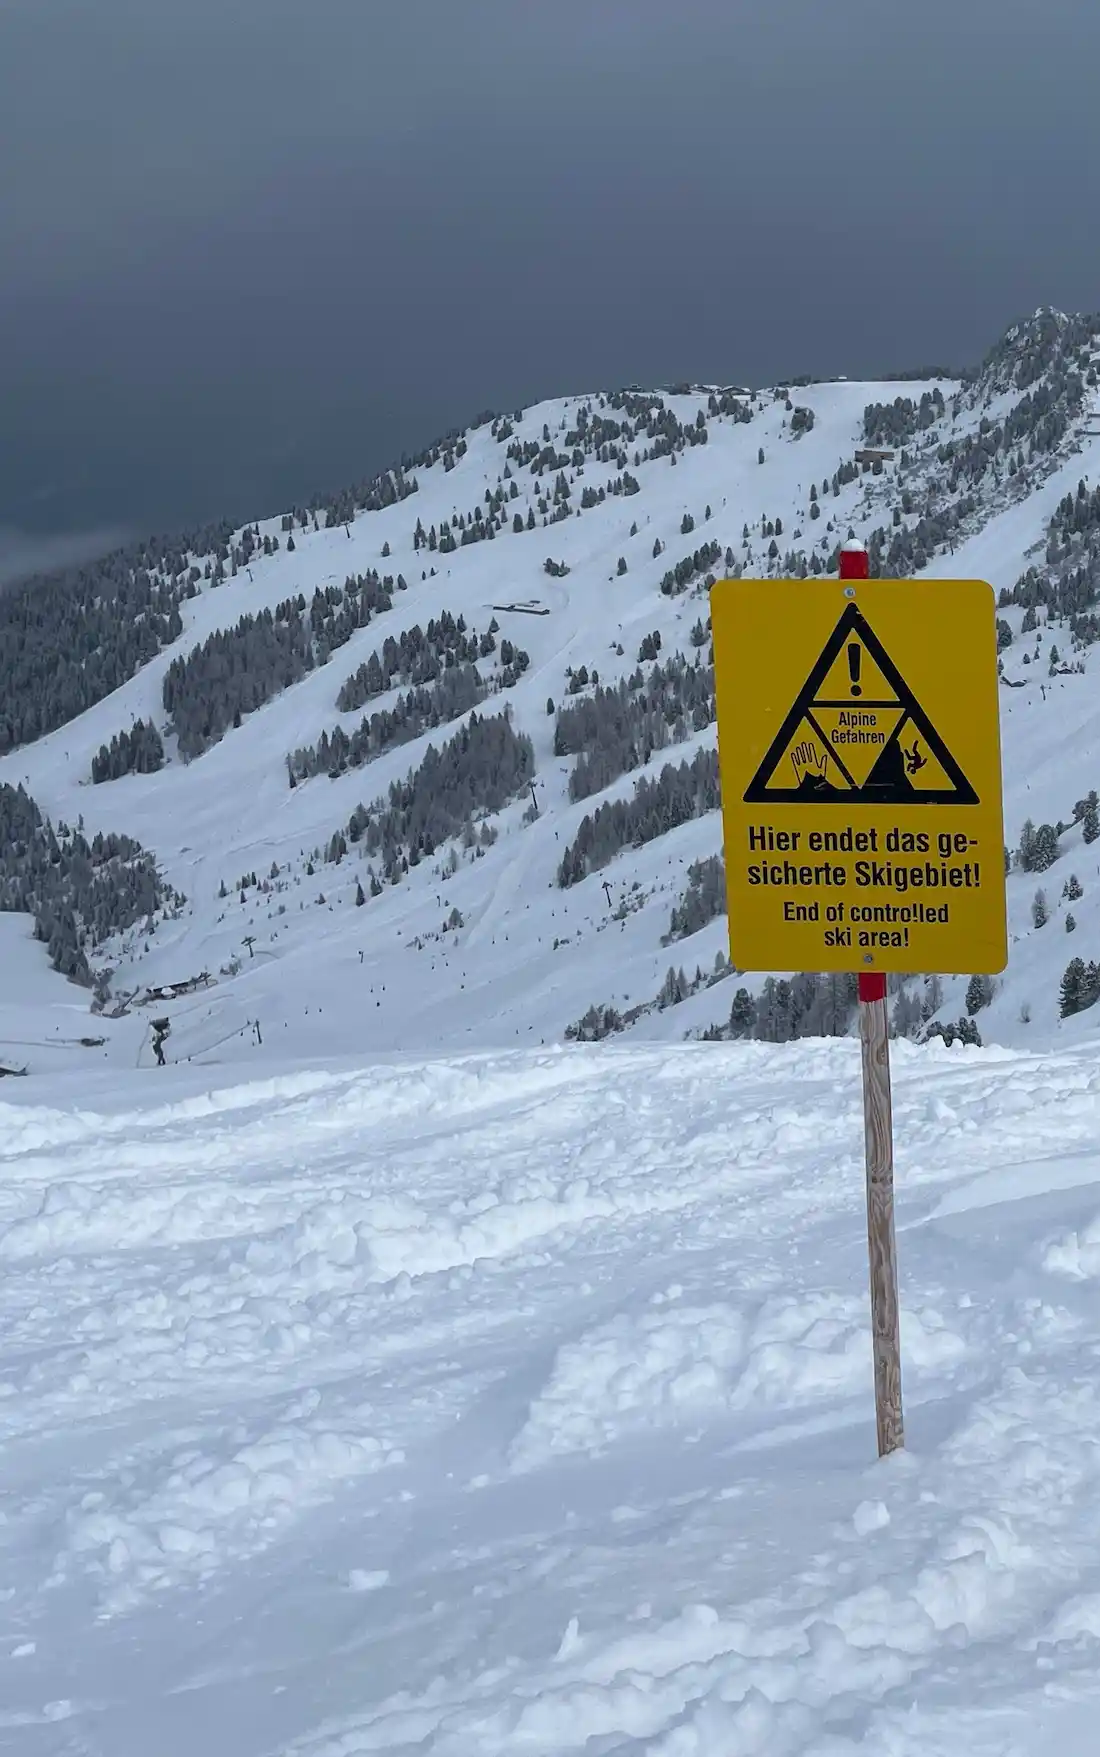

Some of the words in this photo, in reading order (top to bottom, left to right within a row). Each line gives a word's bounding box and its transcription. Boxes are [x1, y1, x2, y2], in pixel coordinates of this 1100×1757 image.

[839, 712, 876, 728] Alpine
[832, 729, 884, 743] Gefahren
[749, 826, 800, 851] Hier
[809, 827, 878, 852] endet
[887, 828, 929, 852] das
[939, 834, 977, 858] ge-
[748, 861, 846, 885] sicherte
[855, 861, 979, 892] Skigebiet!
[784, 902, 818, 921] End
[827, 902, 844, 921] of
[825, 927, 851, 946] ski
[859, 928, 908, 946] area!
